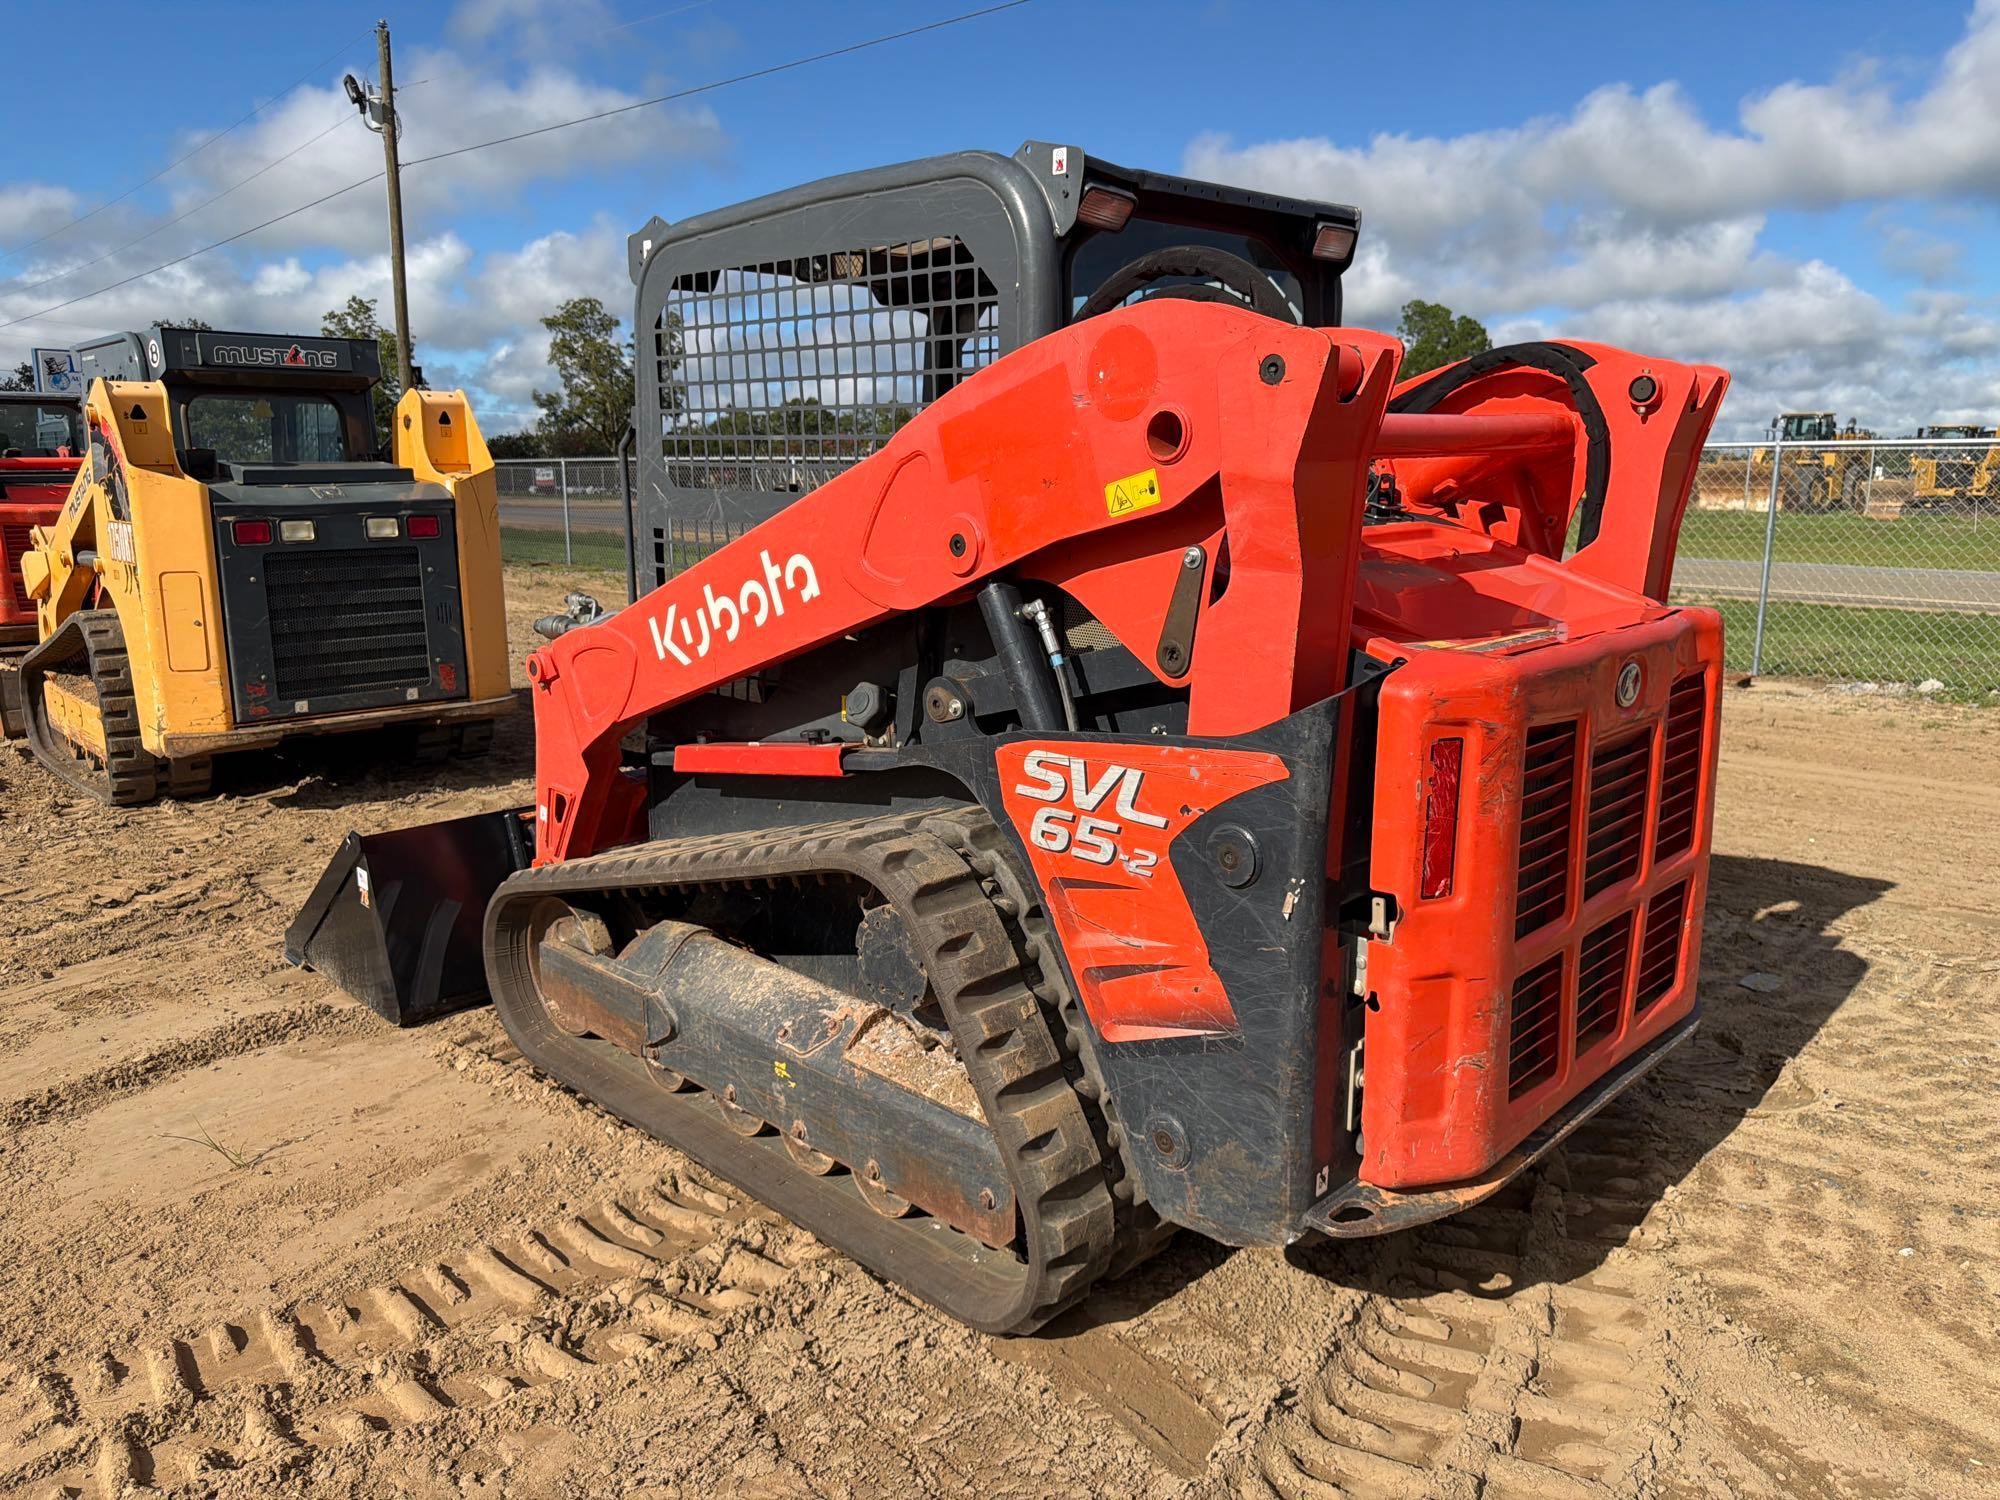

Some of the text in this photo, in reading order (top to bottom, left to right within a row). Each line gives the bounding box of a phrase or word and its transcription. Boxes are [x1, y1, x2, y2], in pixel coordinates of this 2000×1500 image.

[213, 344, 336, 367] MUSTANG
[69, 467, 92, 522] MUSTANG
[648, 549, 821, 666] Kubota
[1015, 749, 1169, 830] SVL
